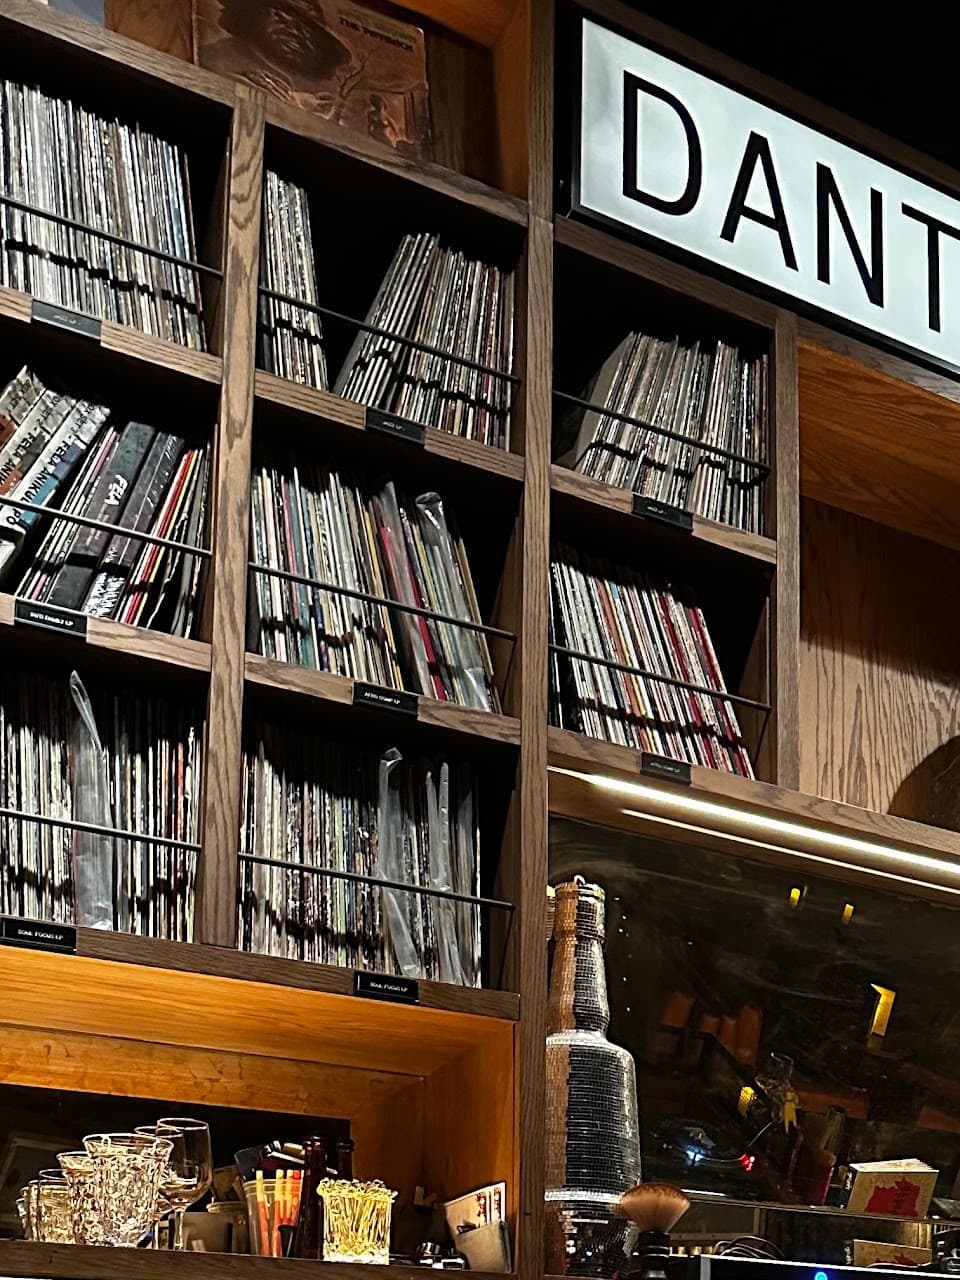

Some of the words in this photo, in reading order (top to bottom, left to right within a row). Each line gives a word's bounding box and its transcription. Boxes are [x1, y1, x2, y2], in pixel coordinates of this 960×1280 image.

[12, 431, 37, 460] FELA
[47, 439, 70, 466] FELA
[104, 474, 129, 507] FELA
